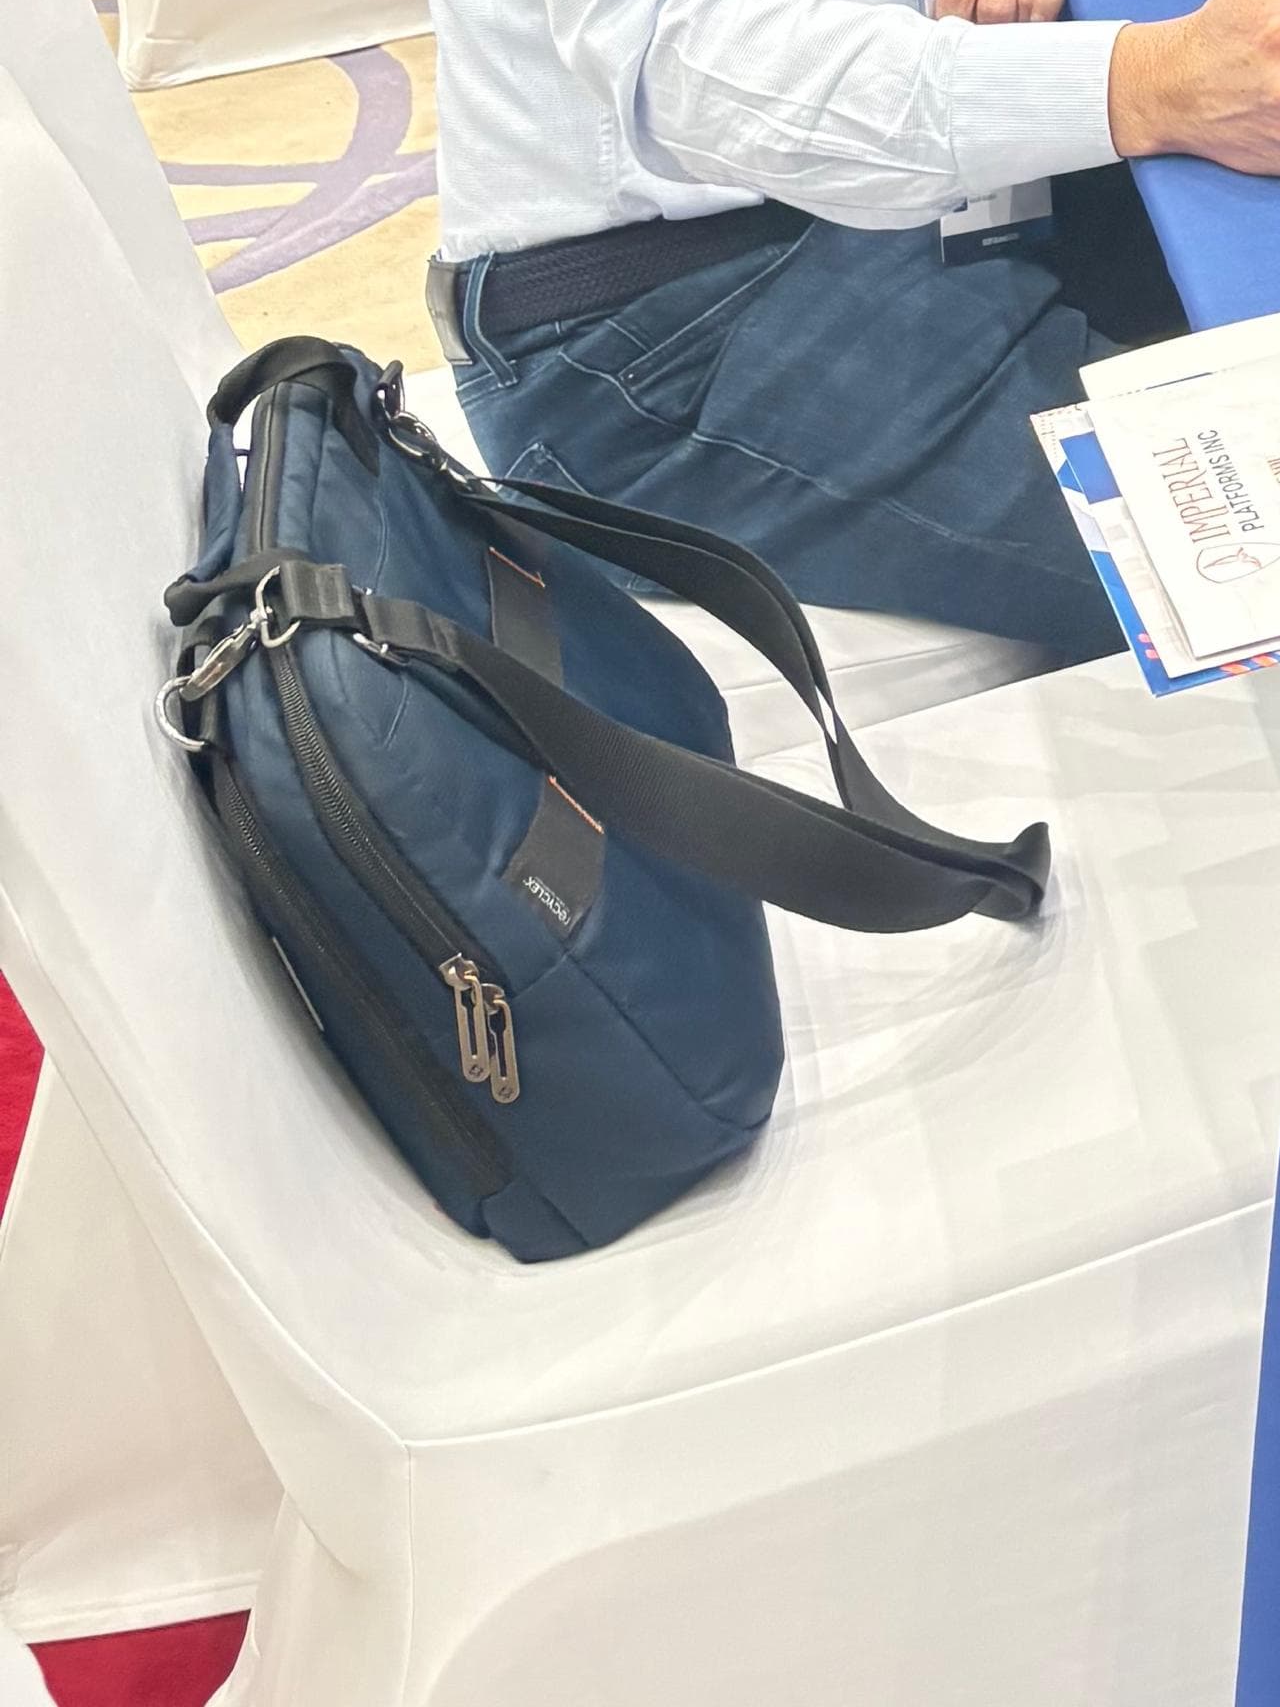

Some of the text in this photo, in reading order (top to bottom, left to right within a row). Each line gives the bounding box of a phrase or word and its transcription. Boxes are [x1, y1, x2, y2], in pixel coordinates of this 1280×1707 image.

[1152, 437, 1232, 544] IMPERIAL
[1197, 429, 1265, 532] PLATFORMS INC
